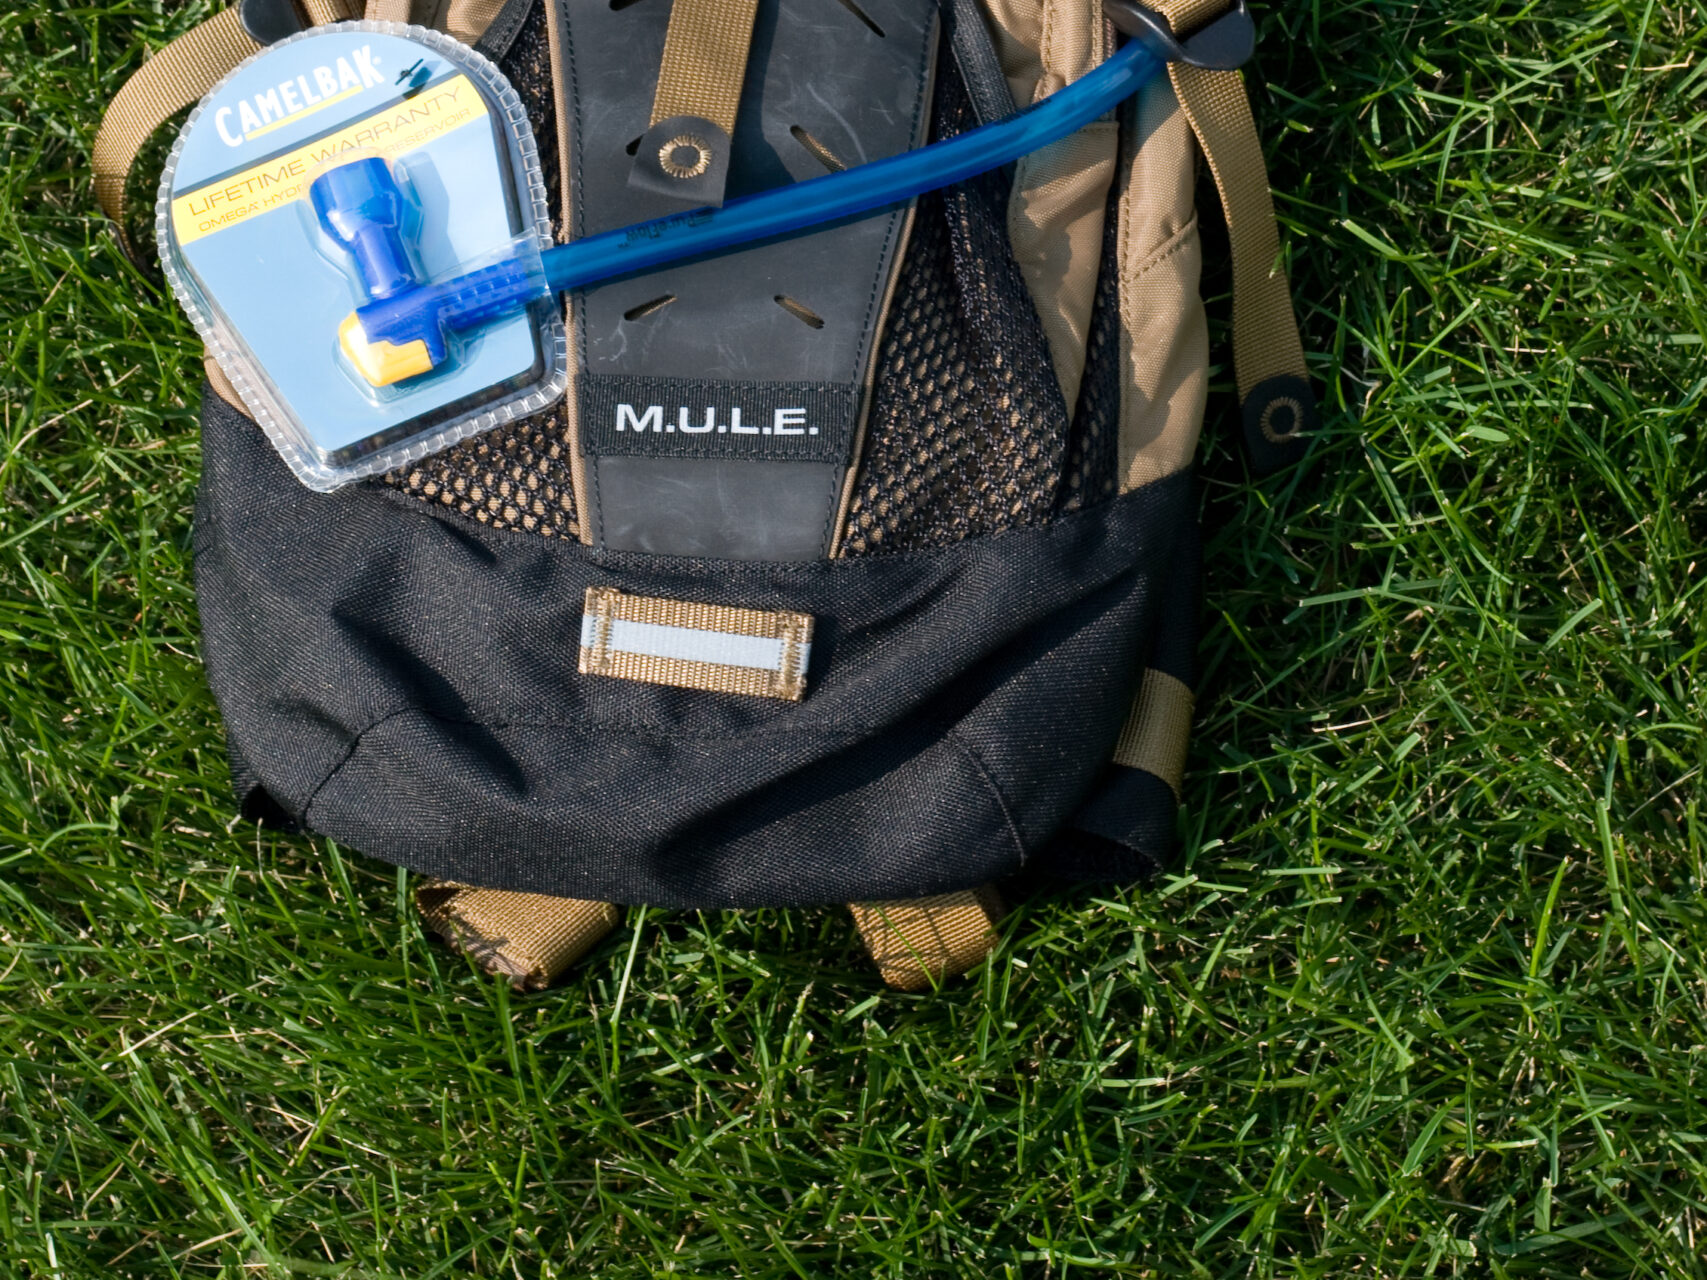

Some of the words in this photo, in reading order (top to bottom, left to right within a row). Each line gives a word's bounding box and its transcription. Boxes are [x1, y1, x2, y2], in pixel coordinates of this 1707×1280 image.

[189, 159, 306, 216] LIFETIME
[310, 85, 460, 162] WARRANTY
[215, 44, 385, 147] CAMELBAK
[198, 203, 259, 232] OMEGA
[384, 108, 471, 153] RESERVOIR
[616, 403, 819, 435] M.U.L.E.
